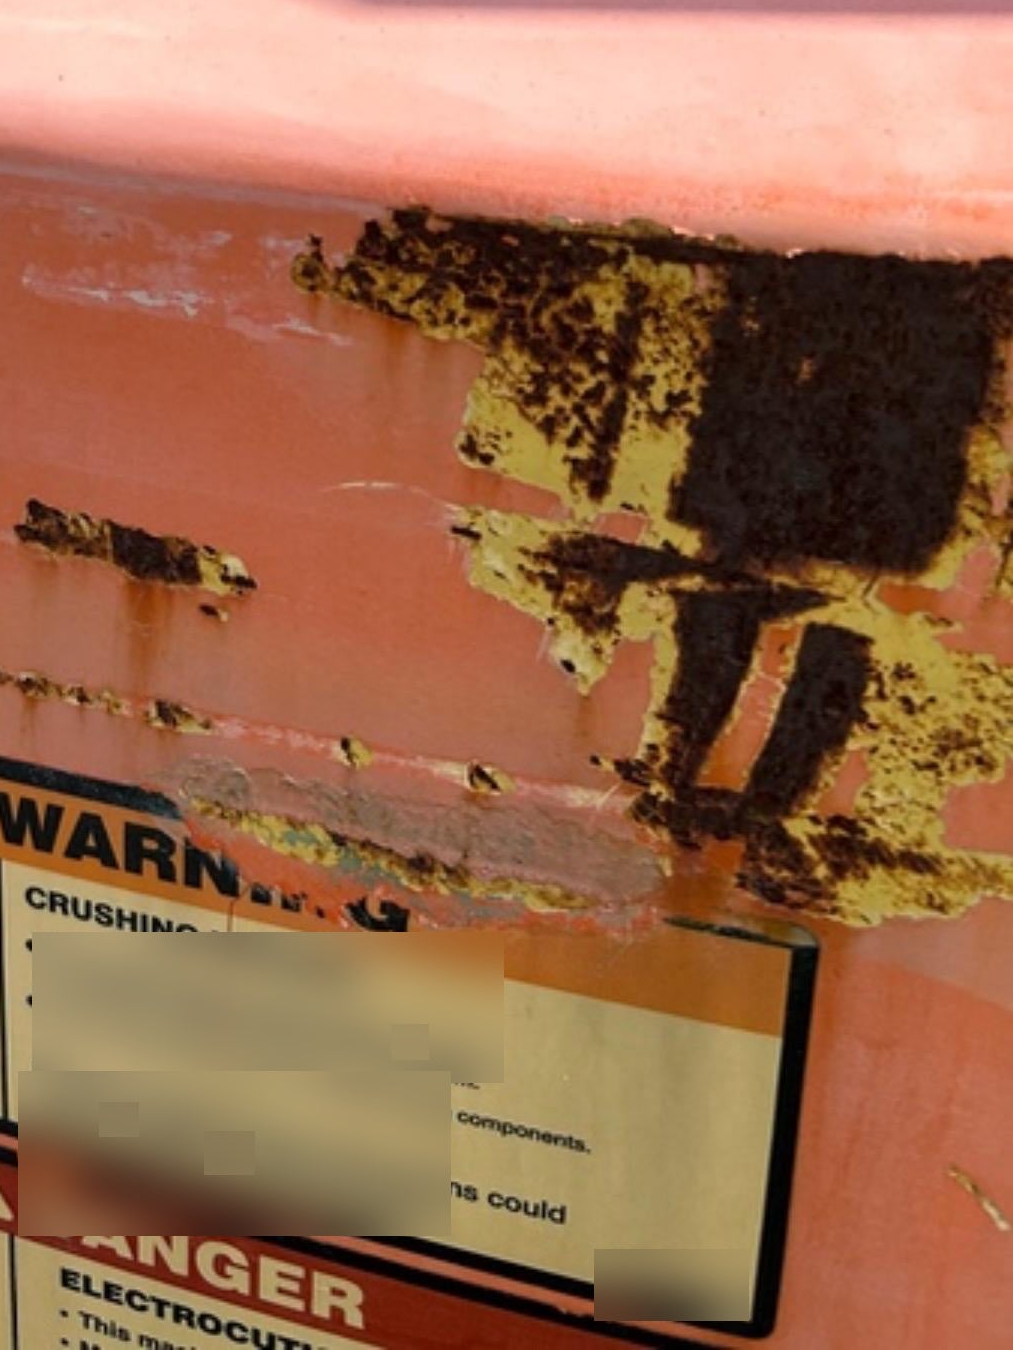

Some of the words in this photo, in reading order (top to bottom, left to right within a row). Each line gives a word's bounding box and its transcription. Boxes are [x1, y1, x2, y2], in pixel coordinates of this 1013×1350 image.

[457, 1110, 591, 1154] components.
[487, 1190, 567, 1225] could
[78, 1310, 131, 1342] This
